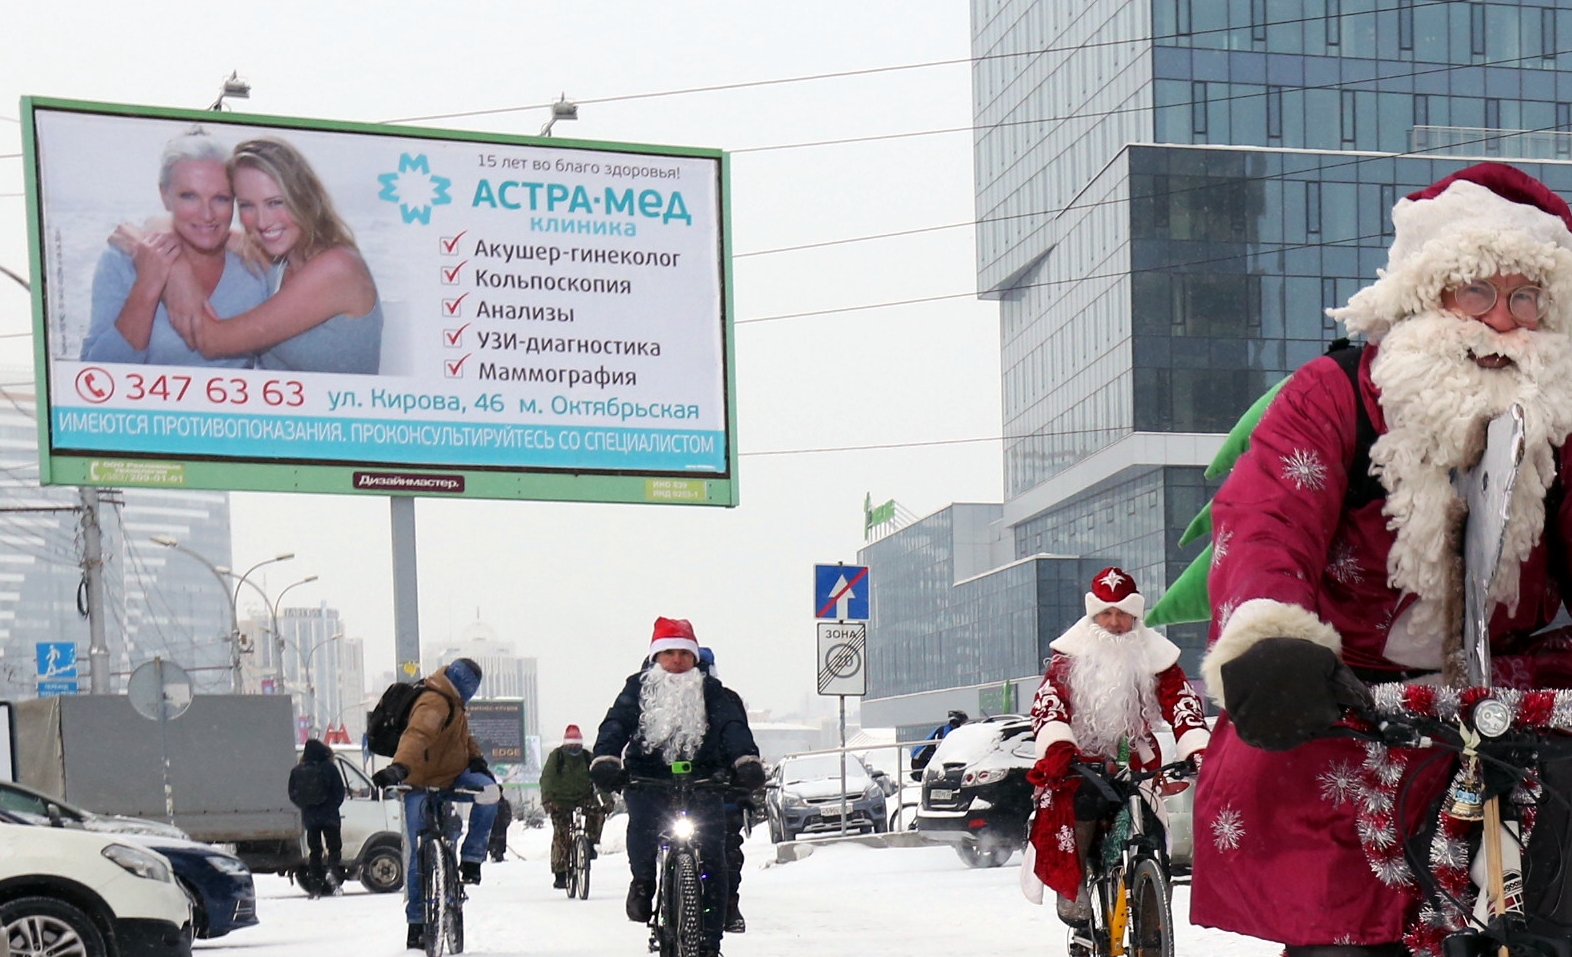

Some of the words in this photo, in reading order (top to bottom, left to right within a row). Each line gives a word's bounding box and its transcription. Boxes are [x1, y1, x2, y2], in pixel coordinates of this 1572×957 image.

[478, 154, 499, 168] 15
[501, 158, 527, 170] лет
[533, 160, 551, 172] во
[555, 158, 600, 175] благо
[604, 164, 681, 180] здоровья!
[530, 216, 637, 238] клиника
[474, 239, 681, 267] Акушер-гинеколог
[475, 269, 632, 294] Кольпоскопия
[476, 300, 575, 322] Анализы
[477, 331, 661, 357] УЗИ-диагностика
[478, 362, 637, 389] Маммография
[125, 374, 192, 401] 347
[206, 377, 249, 404] 63
[262, 380, 305, 407] 63
[328, 390, 364, 411] ул.
[371, 388, 467, 414] Кирова,
[474, 393, 505, 412] 46
[519, 399, 543, 415] м.
[551, 395, 700, 421] Октябрьская
[59, 412, 149, 434] ИМЕЮТСЯ
[153, 415, 347, 443] ПРОТИВОПОКАЗАНИЯ.
[351, 423, 555, 450] ПРОКОНСУЛЬТИРУЙТЕСЬ
[558, 430, 580, 450] СО
[584, 431, 715, 454] СПЕЦИАЛИСТОМ
[359, 474, 460, 490] Дизайнмастер.
[826, 629, 857, 639] ЗОНА
